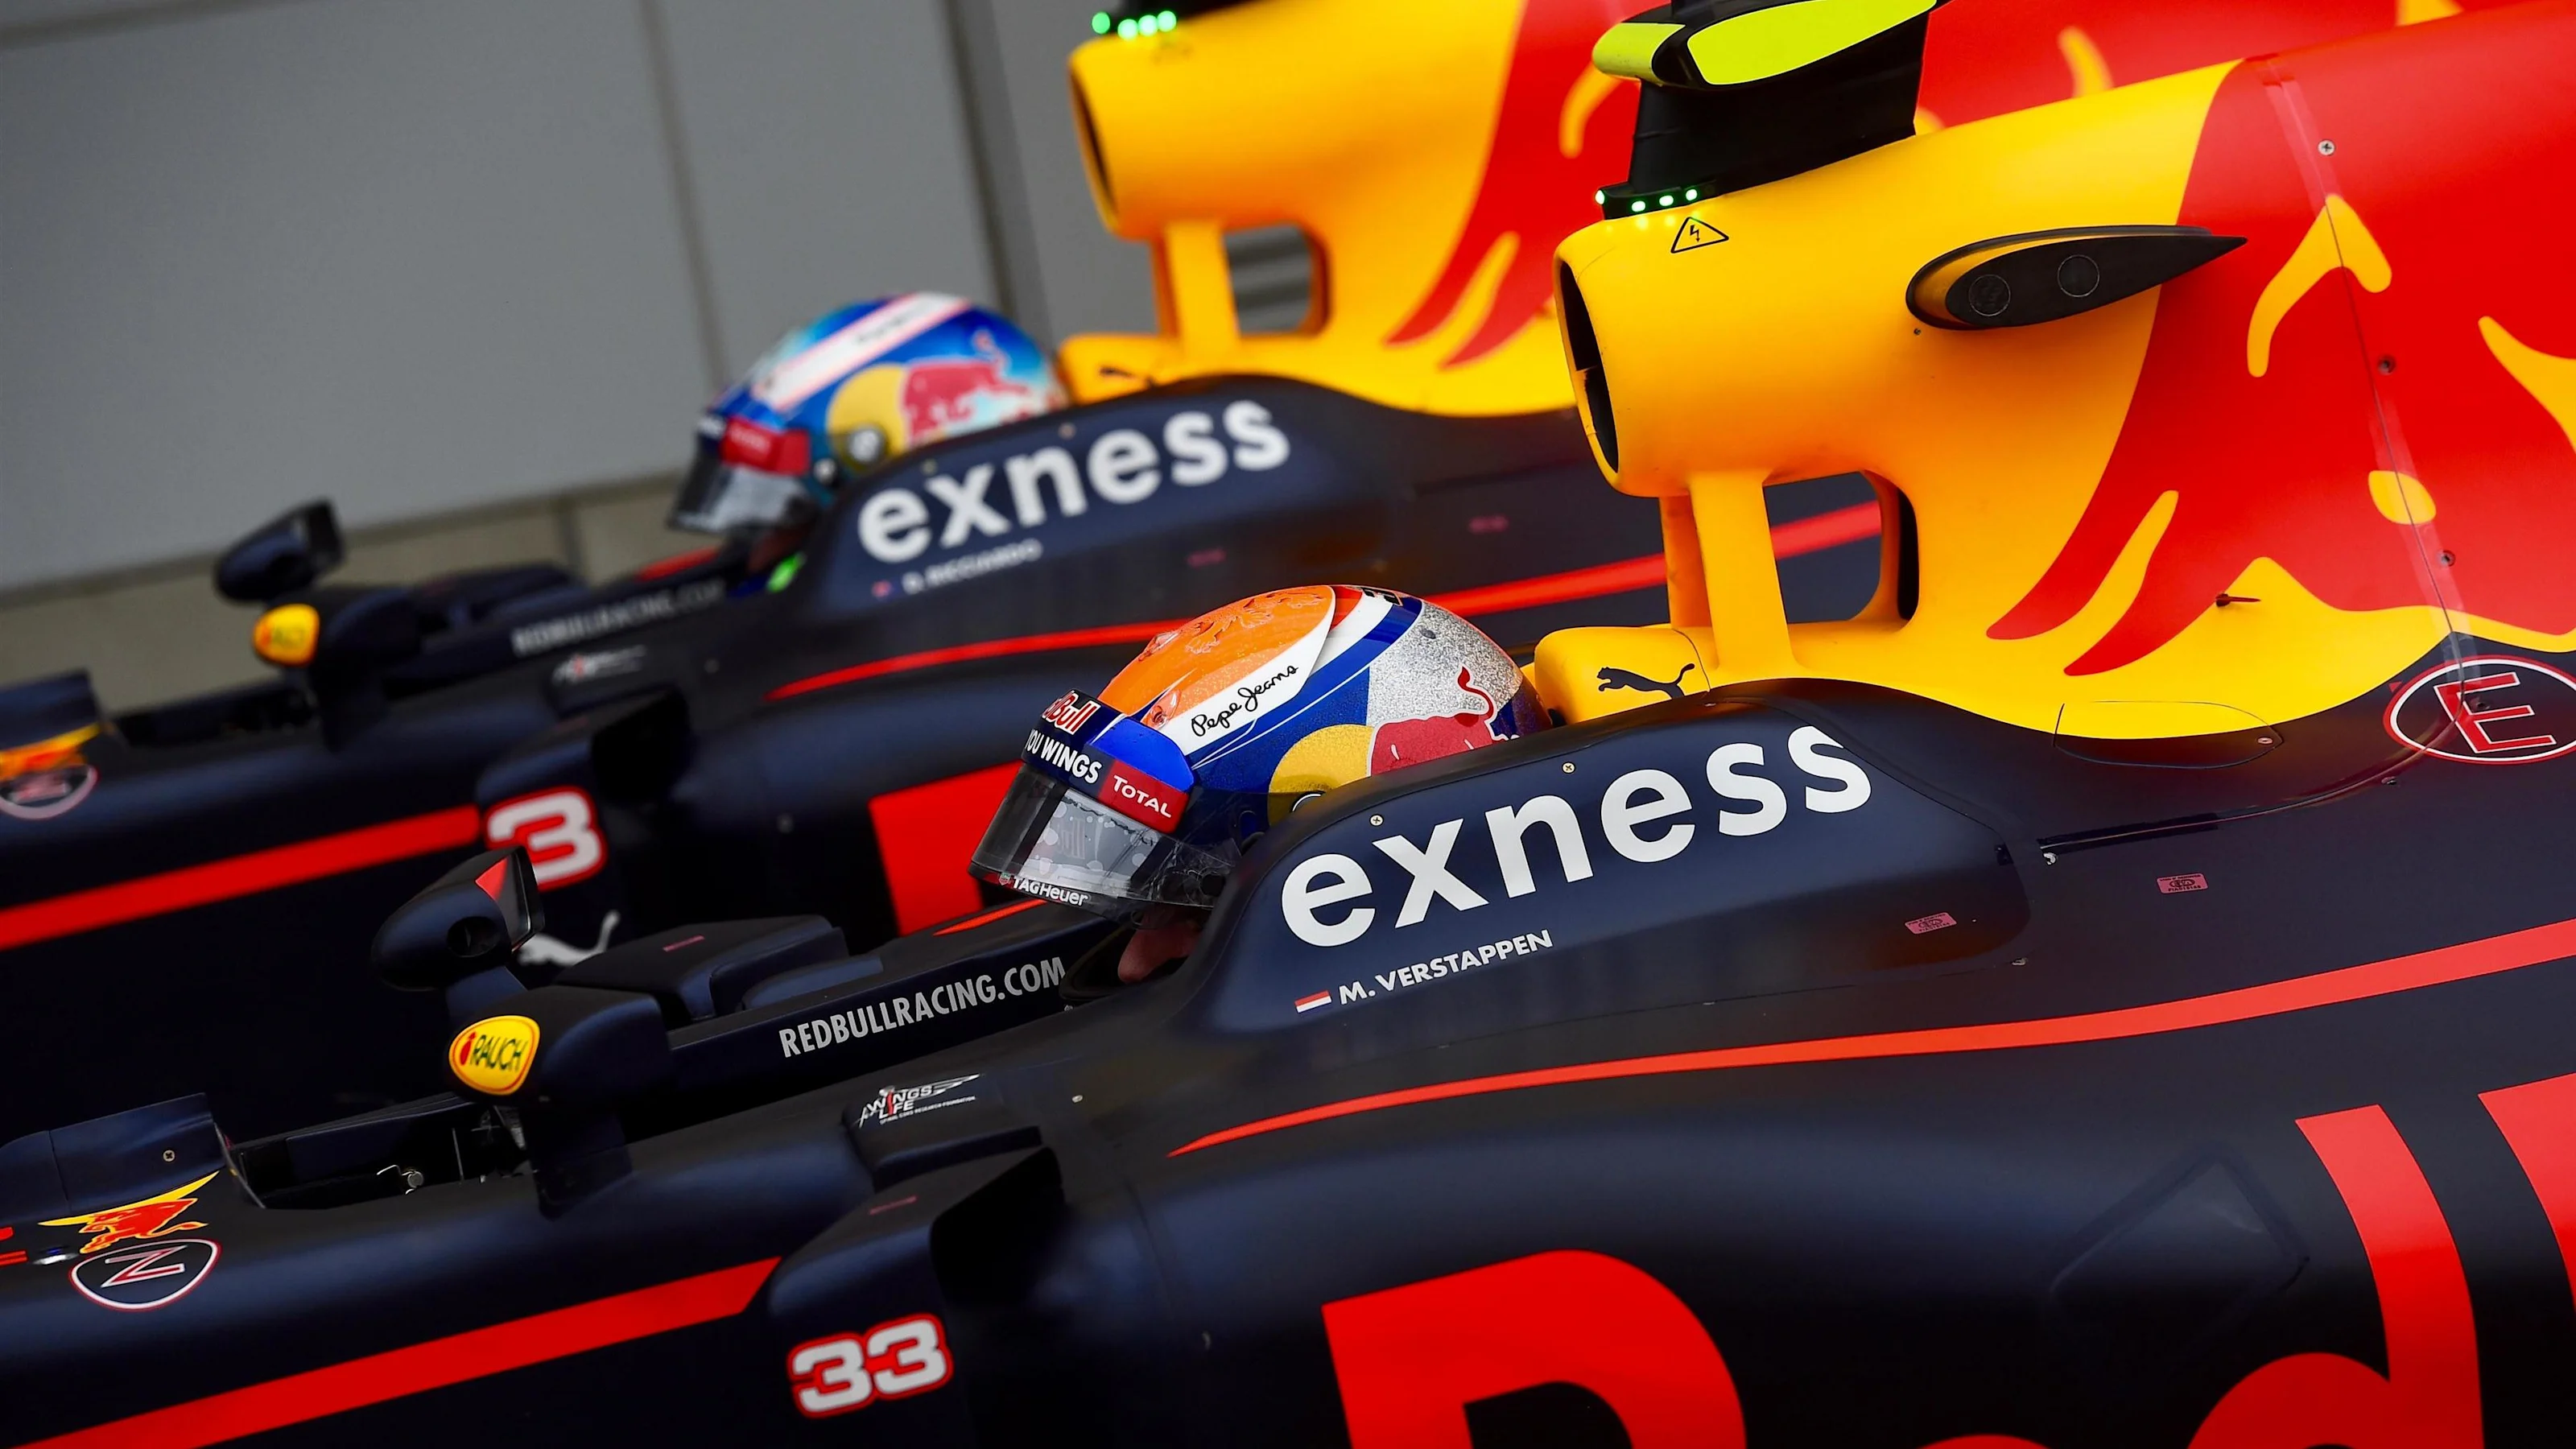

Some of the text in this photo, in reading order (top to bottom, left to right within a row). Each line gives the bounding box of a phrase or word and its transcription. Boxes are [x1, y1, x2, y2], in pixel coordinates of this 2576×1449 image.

[857, 400, 1291, 564] exness
[1191, 666, 1298, 737] Pepe Jeans
[2434, 671, 2557, 754] E
[1041, 736, 1103, 784] WINGS
[1113, 774, 1172, 818] TOTAL
[485, 788, 605, 889] 3
[1281, 725, 1872, 947] exness
[779, 956, 1066, 1058] REDBULLRACING.COM
[1338, 929, 1553, 1005] M. VERSTAPPEN
[469, 1034, 529, 1072] RAUCH
[1321, 1104, 2485, 1449] Rd
[790, 1315, 951, 1415] 33
